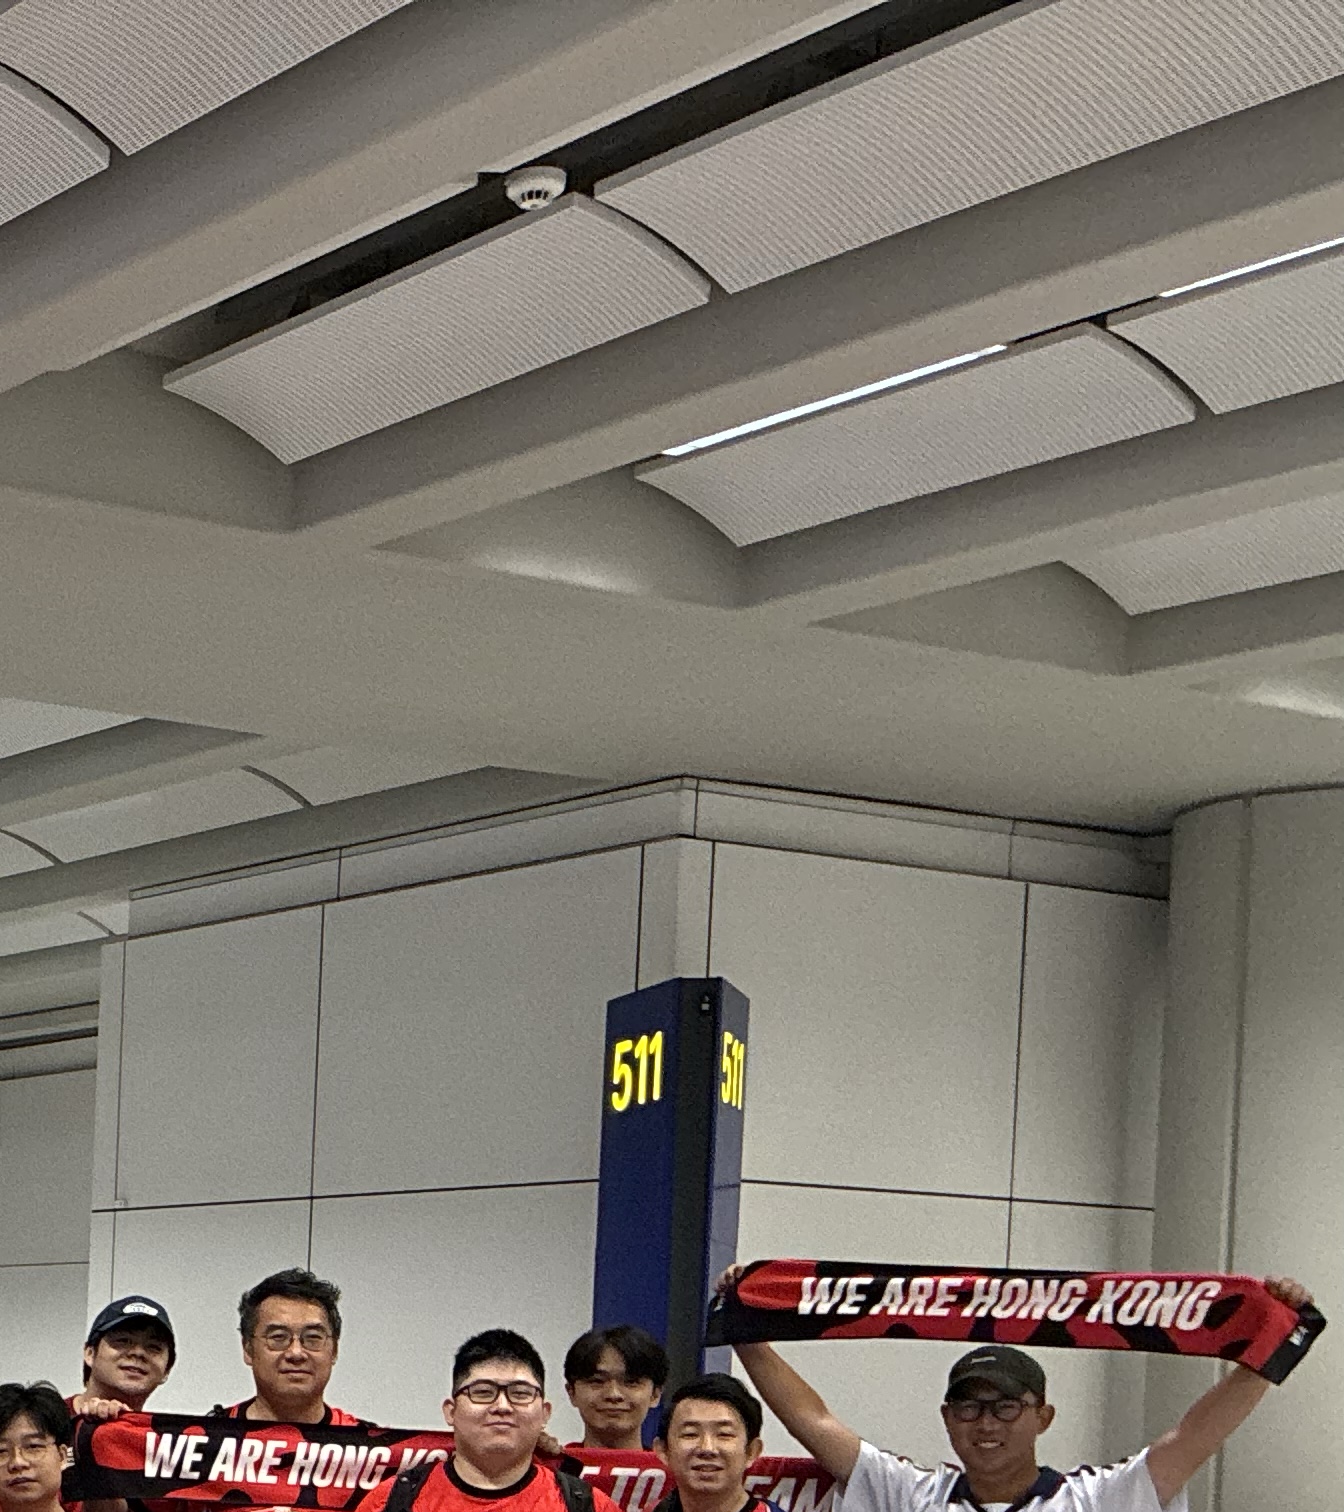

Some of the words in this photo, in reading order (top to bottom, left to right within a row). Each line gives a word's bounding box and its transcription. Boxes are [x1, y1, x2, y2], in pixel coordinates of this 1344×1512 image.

[612, 1031, 663, 1112] 511
[721, 1031, 745, 1110] 511
[797, 1276, 875, 1316] WE
[868, 1277, 964, 1317] ARE
[961, 1279, 1087, 1324] HONG
[1085, 1280, 1223, 1332] KONG
[143, 1431, 210, 1480] WE
[208, 1436, 288, 1485] ARE
[286, 1441, 392, 1490] HONG
